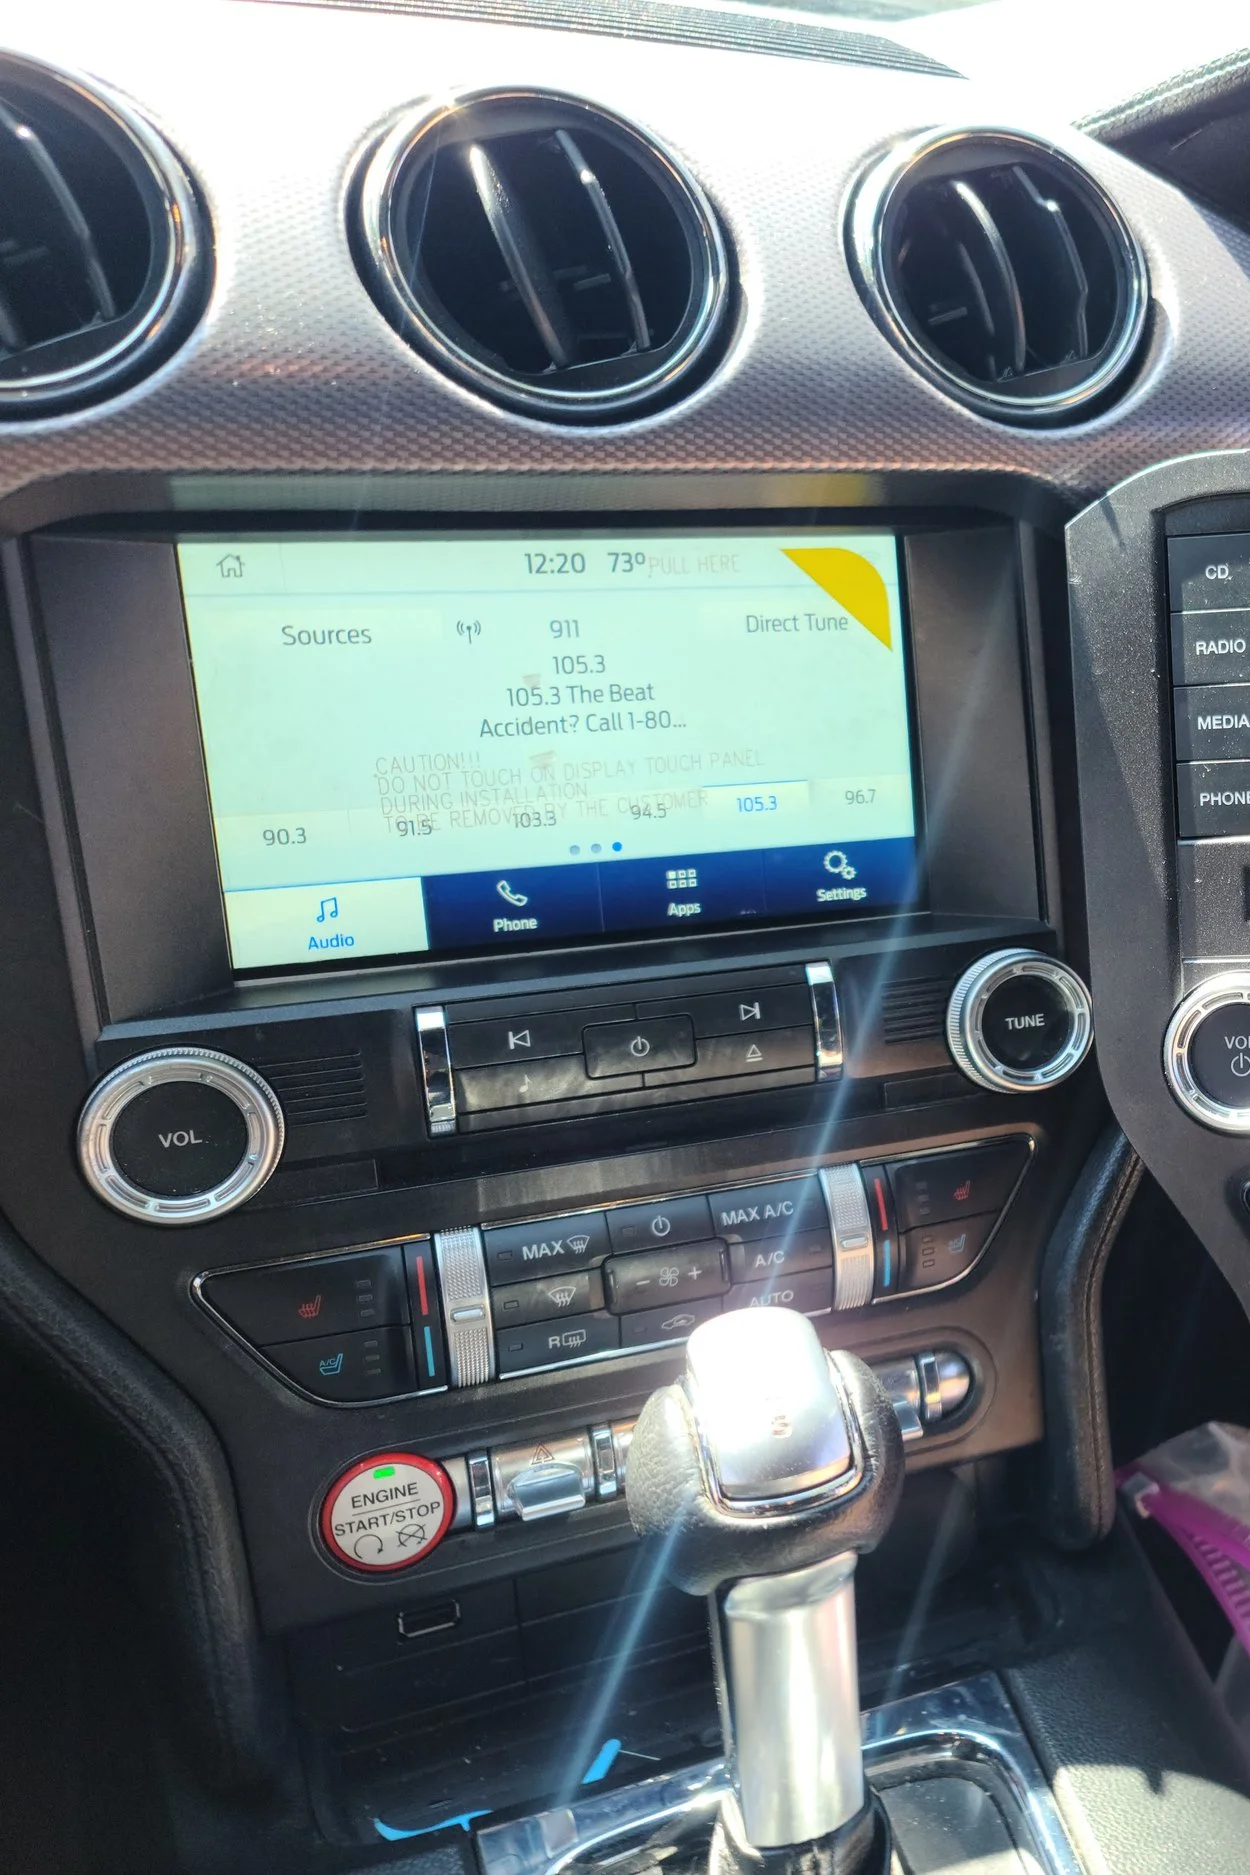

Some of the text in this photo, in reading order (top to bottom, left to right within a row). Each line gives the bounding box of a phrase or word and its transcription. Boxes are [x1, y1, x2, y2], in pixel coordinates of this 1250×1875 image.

[525, 552, 586, 575] 12:20
[649, 553, 741, 577] PULL HERE
[1205, 565, 1229, 580] CD
[550, 619, 580, 639] 911
[746, 613, 849, 634] Direct Tune
[281, 625, 372, 647] Sources
[1196, 639, 1246, 656] RADIO
[552, 655, 606, 675] 105.3
[507, 682, 655, 707] 105.3 The Beat
[480, 714, 580, 738] Accident?
[586, 711, 623, 733] Call
[1198, 714, 1250, 730] MEDIA
[375, 751, 481, 775] CAUTION!!!
[378, 749, 765, 795] DO NOT TOUCH ON DISPLAY TOUCH PANEL
[380, 782, 588, 815] DURING INSTALLATION
[737, 795, 778, 813] 105.3
[844, 788, 876, 806] 96.7
[576, 798, 609, 818] THE
[630, 802, 667, 820] 94.5
[396, 819, 433, 837] 91.5
[513, 811, 557, 829] 103.3
[262, 827, 307, 846] 90.3
[816, 887, 867, 903] Settings
[667, 902, 701, 917] Apps
[493, 917, 538, 933] Phone
[308, 934, 355, 951] Audio
[1005, 1013, 1046, 1031] TUNE
[158, 1129, 203, 1149] VOL
[721, 1200, 795, 1227] MAX A/C
[522, 1240, 565, 1261] MAX
[755, 1250, 786, 1268] A/C
[750, 1290, 794, 1308] AUTO
[351, 1481, 419, 1509] ENGINE
[335, 1500, 441, 1537] START/STOP
